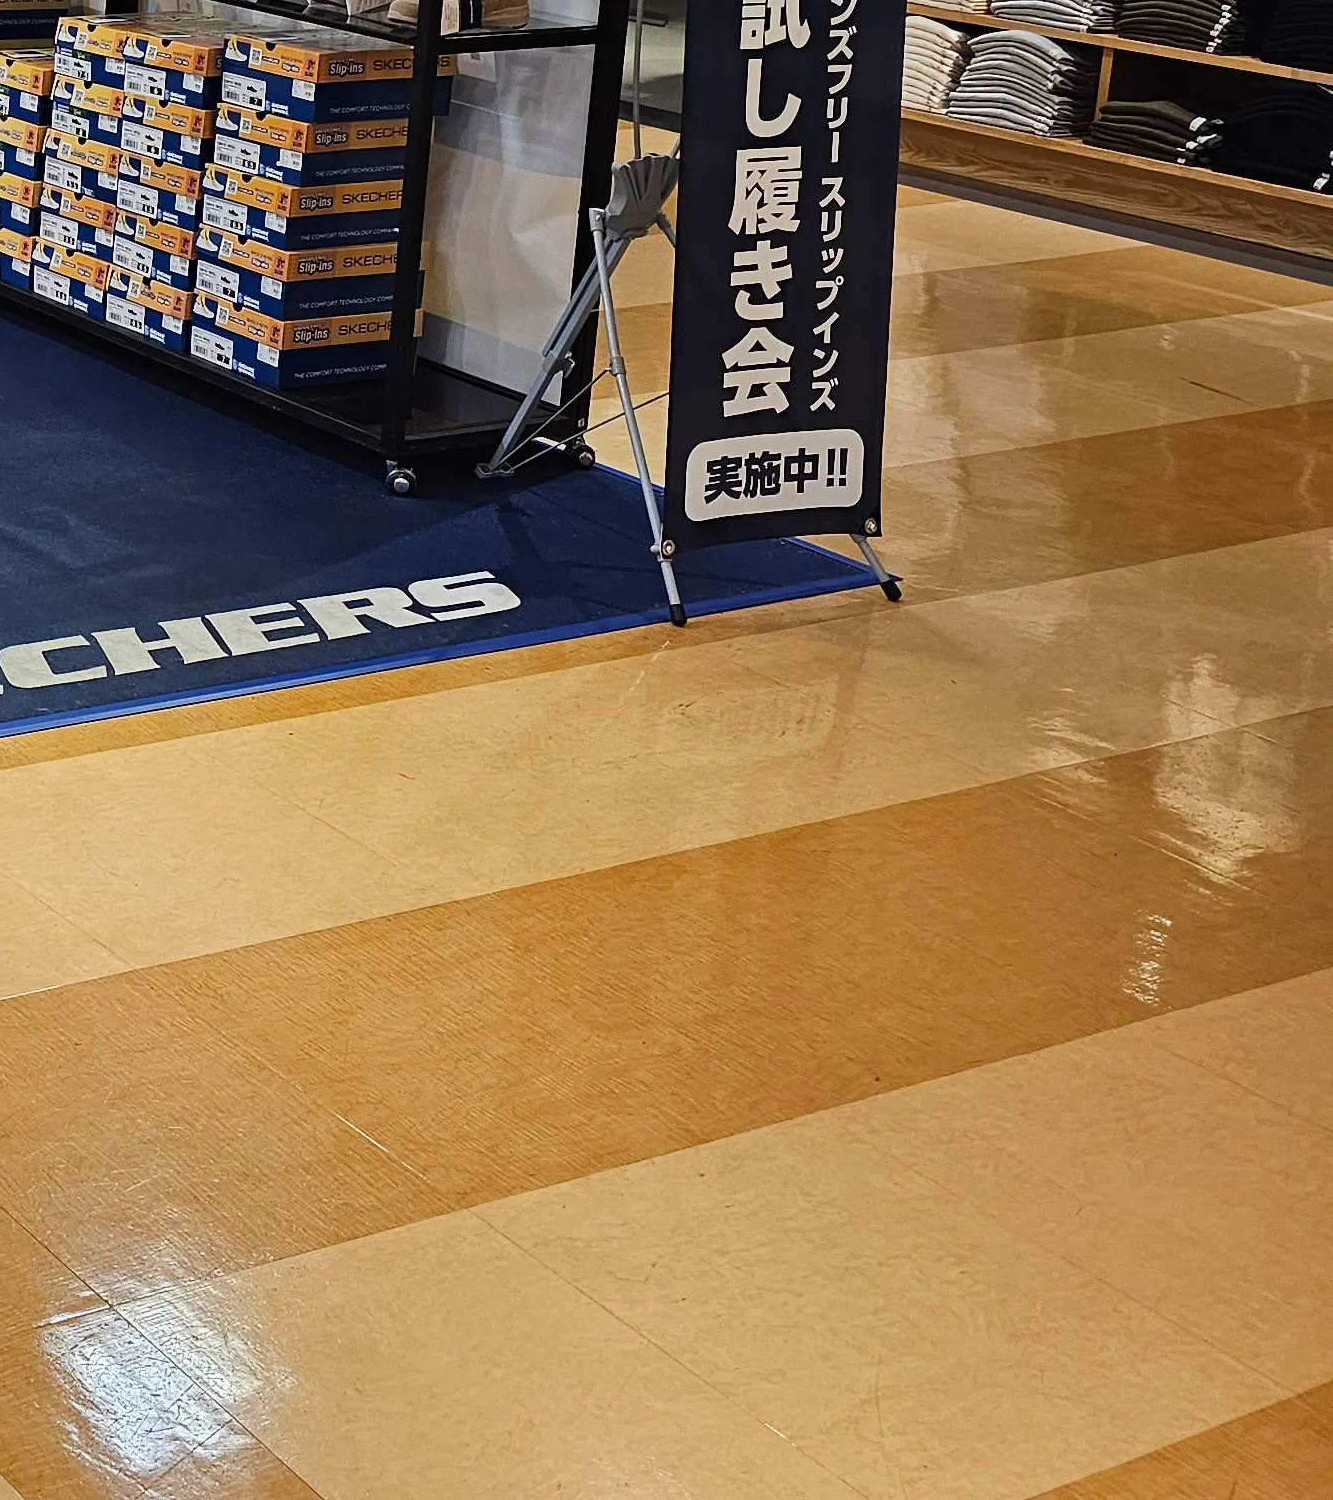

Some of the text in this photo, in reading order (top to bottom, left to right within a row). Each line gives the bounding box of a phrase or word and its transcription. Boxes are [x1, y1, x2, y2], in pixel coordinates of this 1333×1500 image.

[330, 63, 364, 76] Slip-ins
[316, 133, 347, 146] Slip-ins
[300, 198, 332, 210] Slip-ins
[299, 261, 333, 274] Slip-ins
[810, 176, 847, 412] スリップインズ
[295, 330, 329, 343] Slip-ins
[704, 447, 849, 504] 実施中!!
